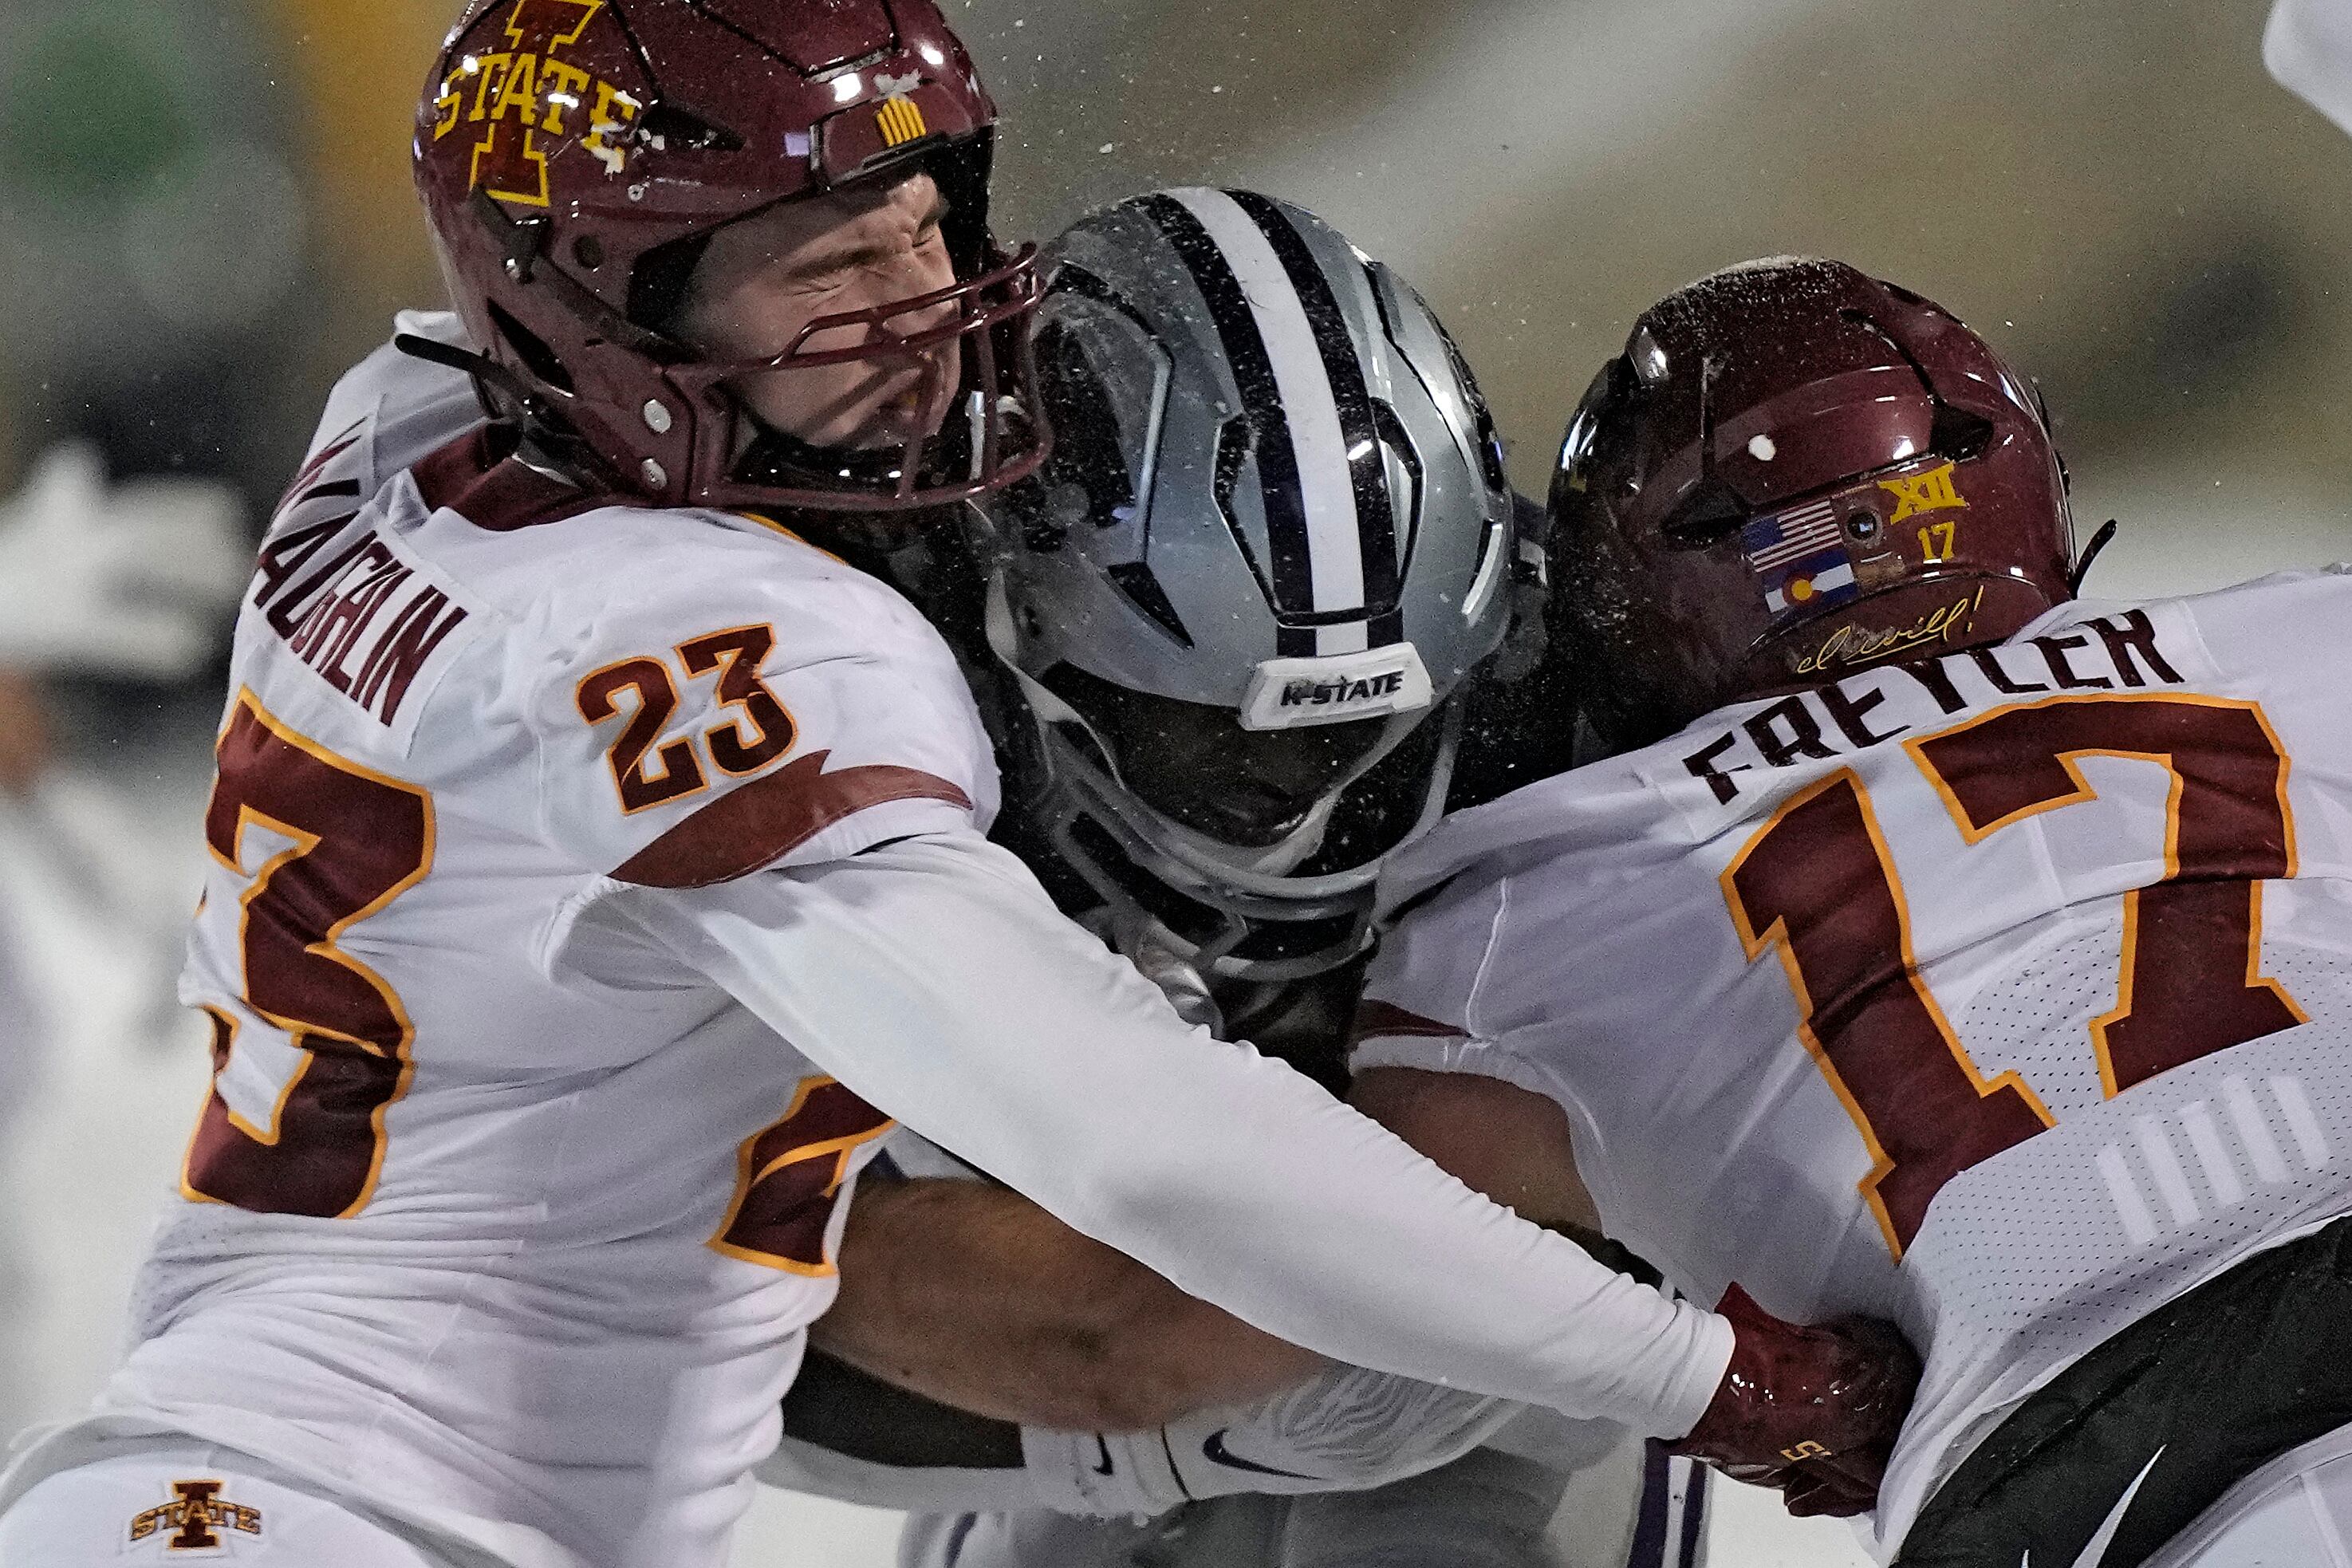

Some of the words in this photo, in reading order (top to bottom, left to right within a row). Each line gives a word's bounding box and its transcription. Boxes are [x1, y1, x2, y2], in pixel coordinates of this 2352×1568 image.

[432, 52, 643, 177] STATE
[1877, 460, 1968, 526] XII
[1917, 521, 1955, 563] 17
[575, 622, 798, 816] 23
[1719, 691, 2315, 1266] 17
